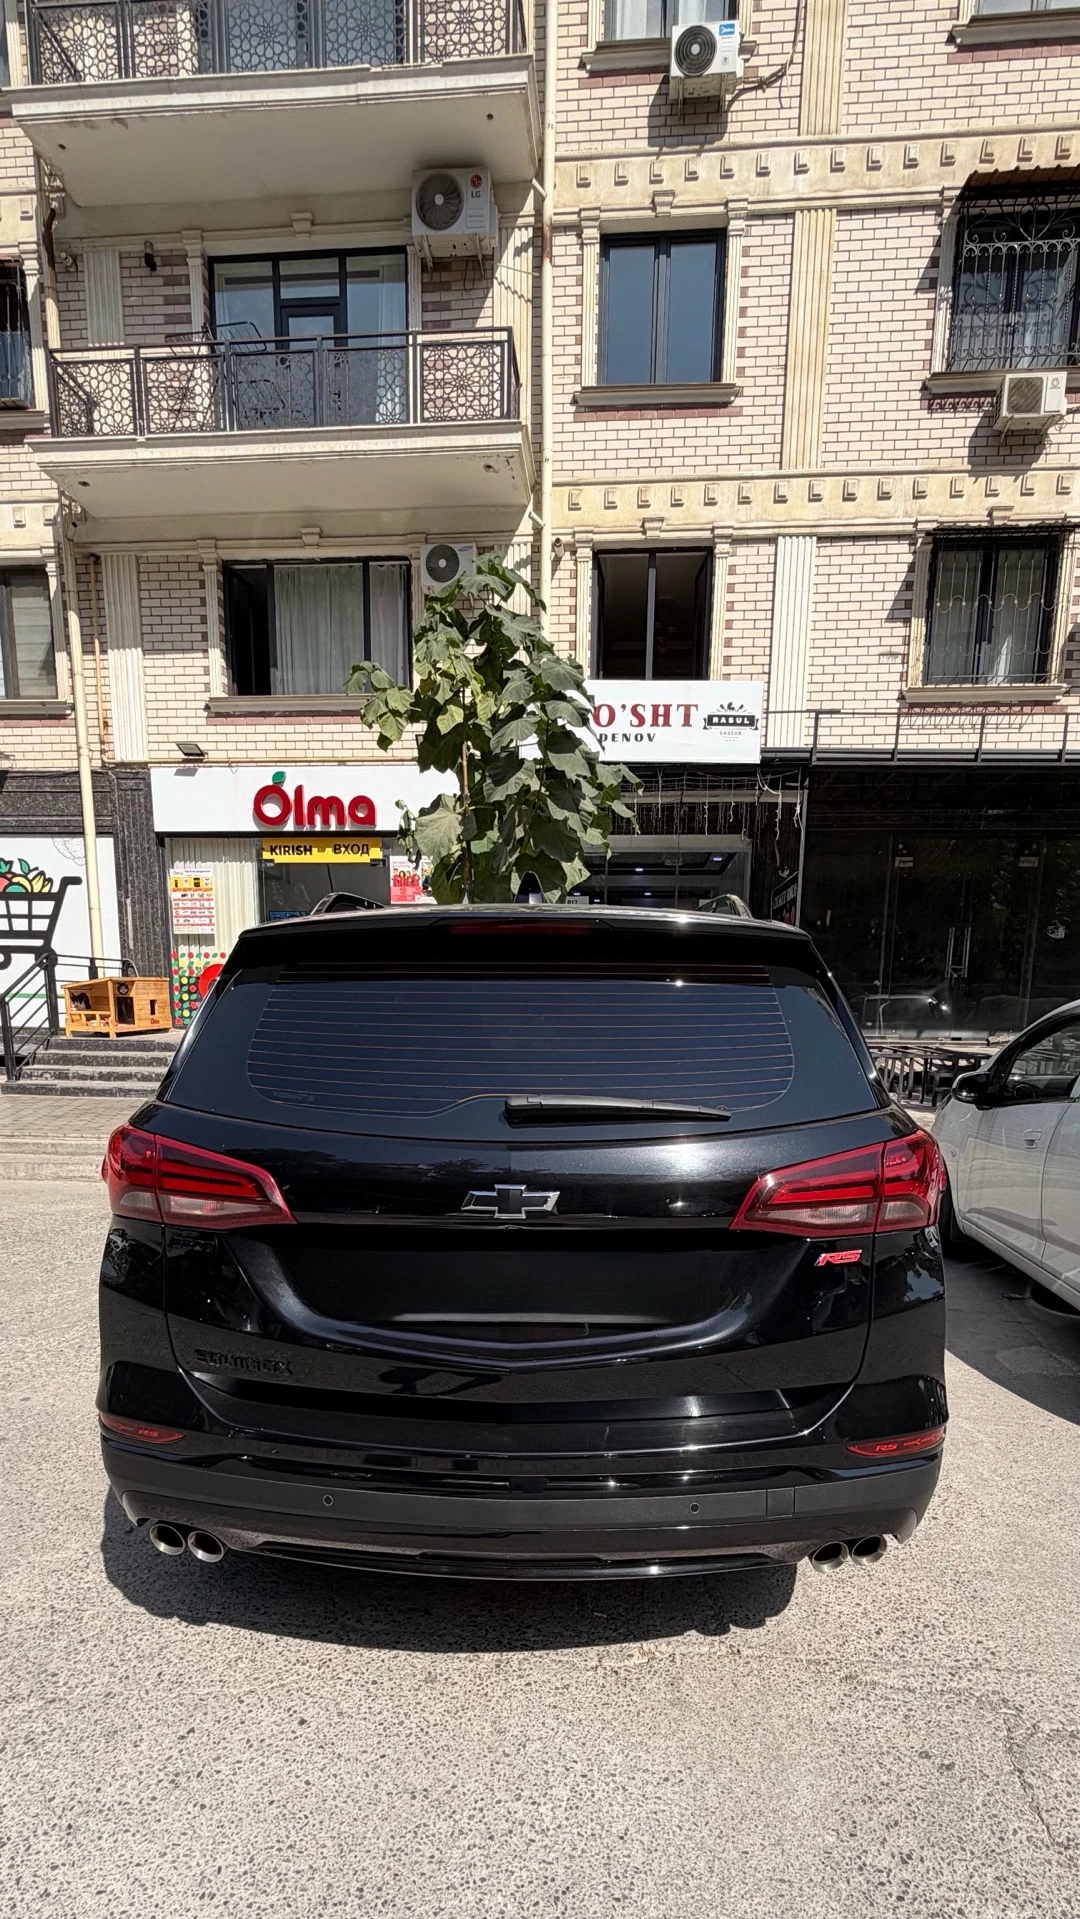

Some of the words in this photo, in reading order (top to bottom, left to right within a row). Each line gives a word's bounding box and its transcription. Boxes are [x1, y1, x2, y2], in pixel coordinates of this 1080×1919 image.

[566, 703, 699, 728] O'SHT
[712, 716, 750, 724] RASUL
[253, 782, 377, 827] Olma
[269, 845, 313, 855] KIRISH
[333, 843, 370, 856] ВХОД
[814, 1249, 862, 1266] RS
[875, 1443, 898, 1452] RS
